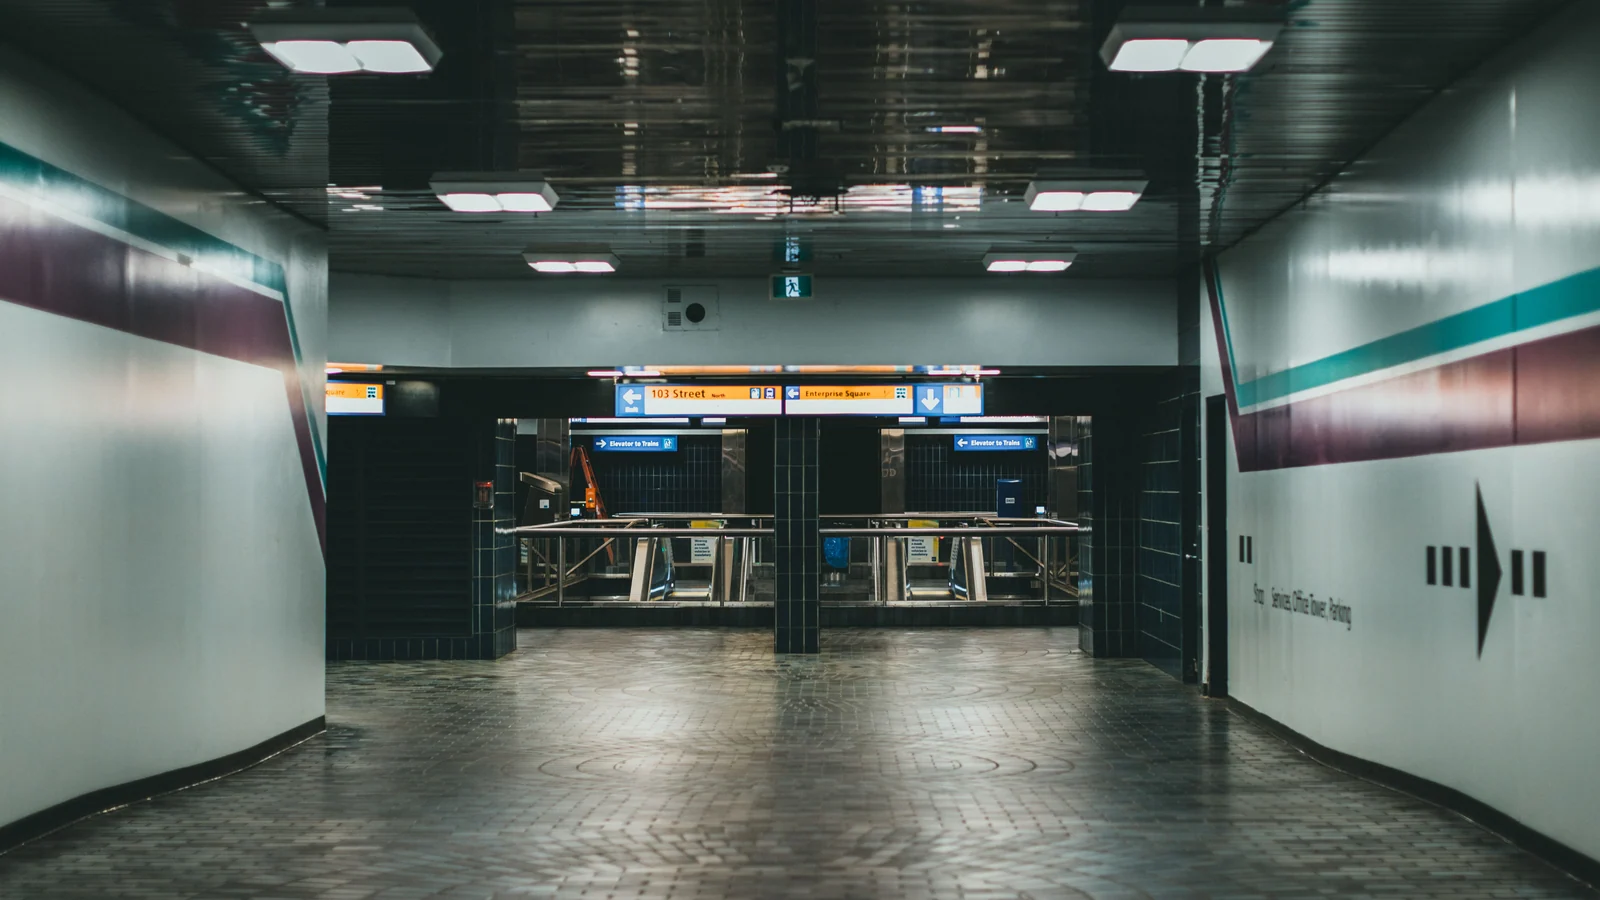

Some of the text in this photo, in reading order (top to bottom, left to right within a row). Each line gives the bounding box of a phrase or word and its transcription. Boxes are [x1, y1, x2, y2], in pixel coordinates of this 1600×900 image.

[652, 389, 669, 399] 103
[673, 389, 706, 399] Street
[805, 390, 871, 399] Enterprise Square
[1292, 589, 1309, 615] Office
[1309, 593, 1329, 621] Tower,
[1329, 597, 1352, 631] Parking
